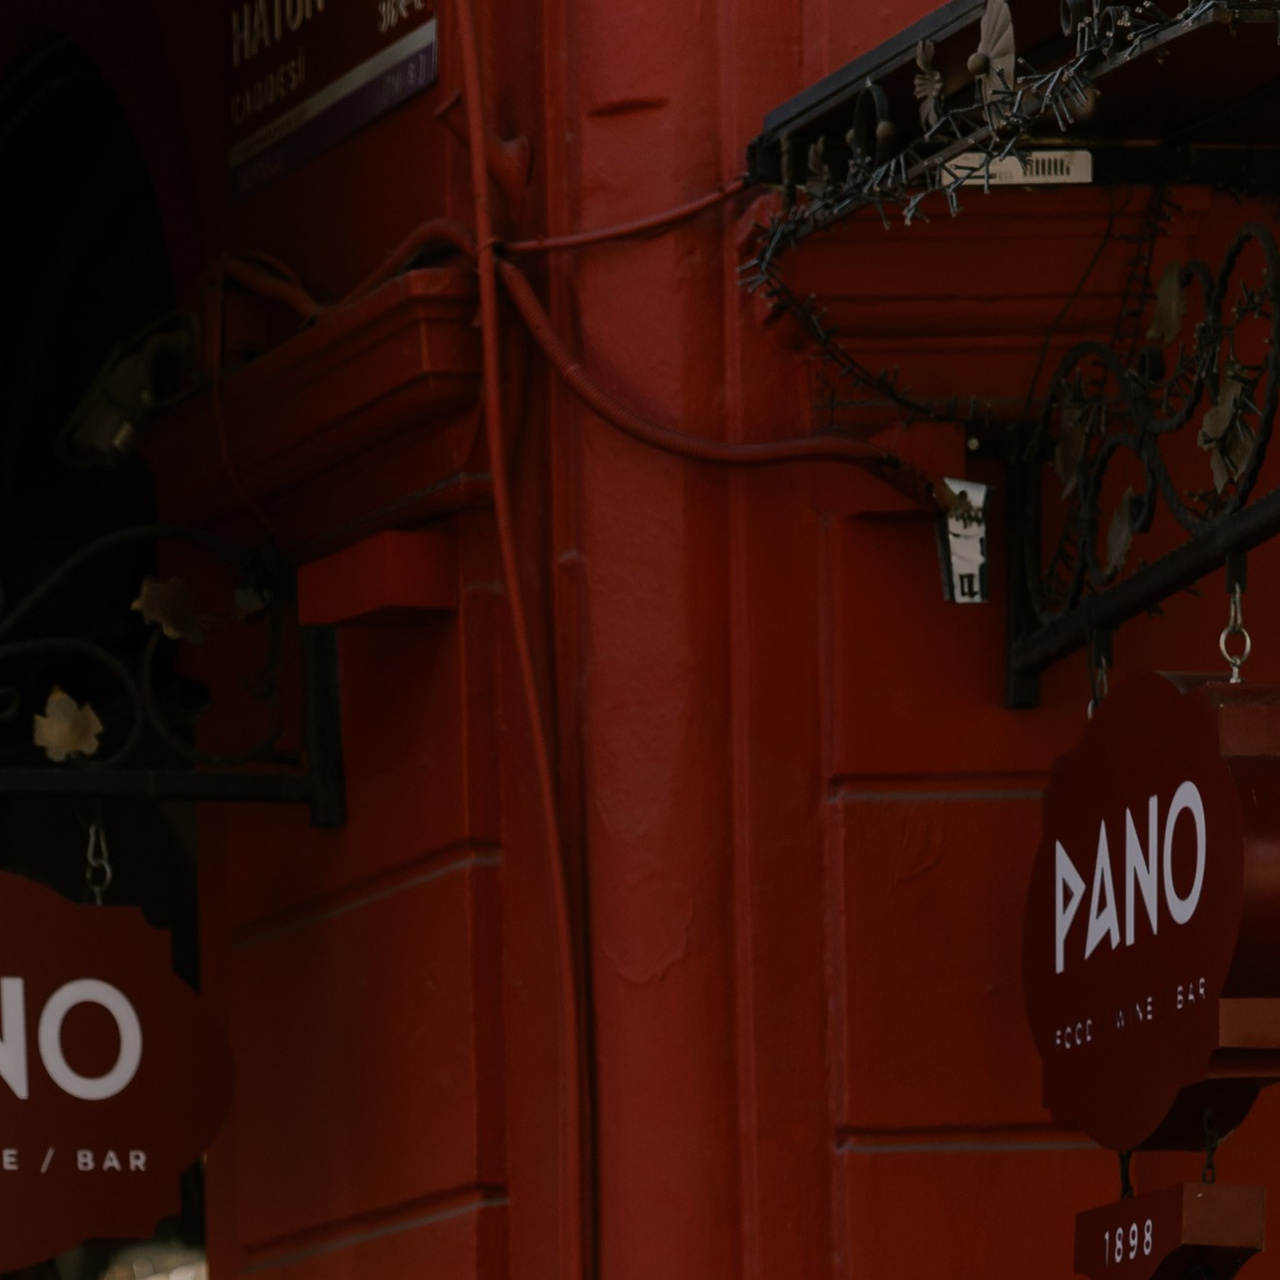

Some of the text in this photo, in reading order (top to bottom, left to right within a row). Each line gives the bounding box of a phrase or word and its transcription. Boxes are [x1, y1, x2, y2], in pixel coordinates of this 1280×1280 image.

[1054, 779, 1207, 975] PANO
[75, 1148, 148, 1173] BAR
[1103, 1217, 1153, 1267] 1898
